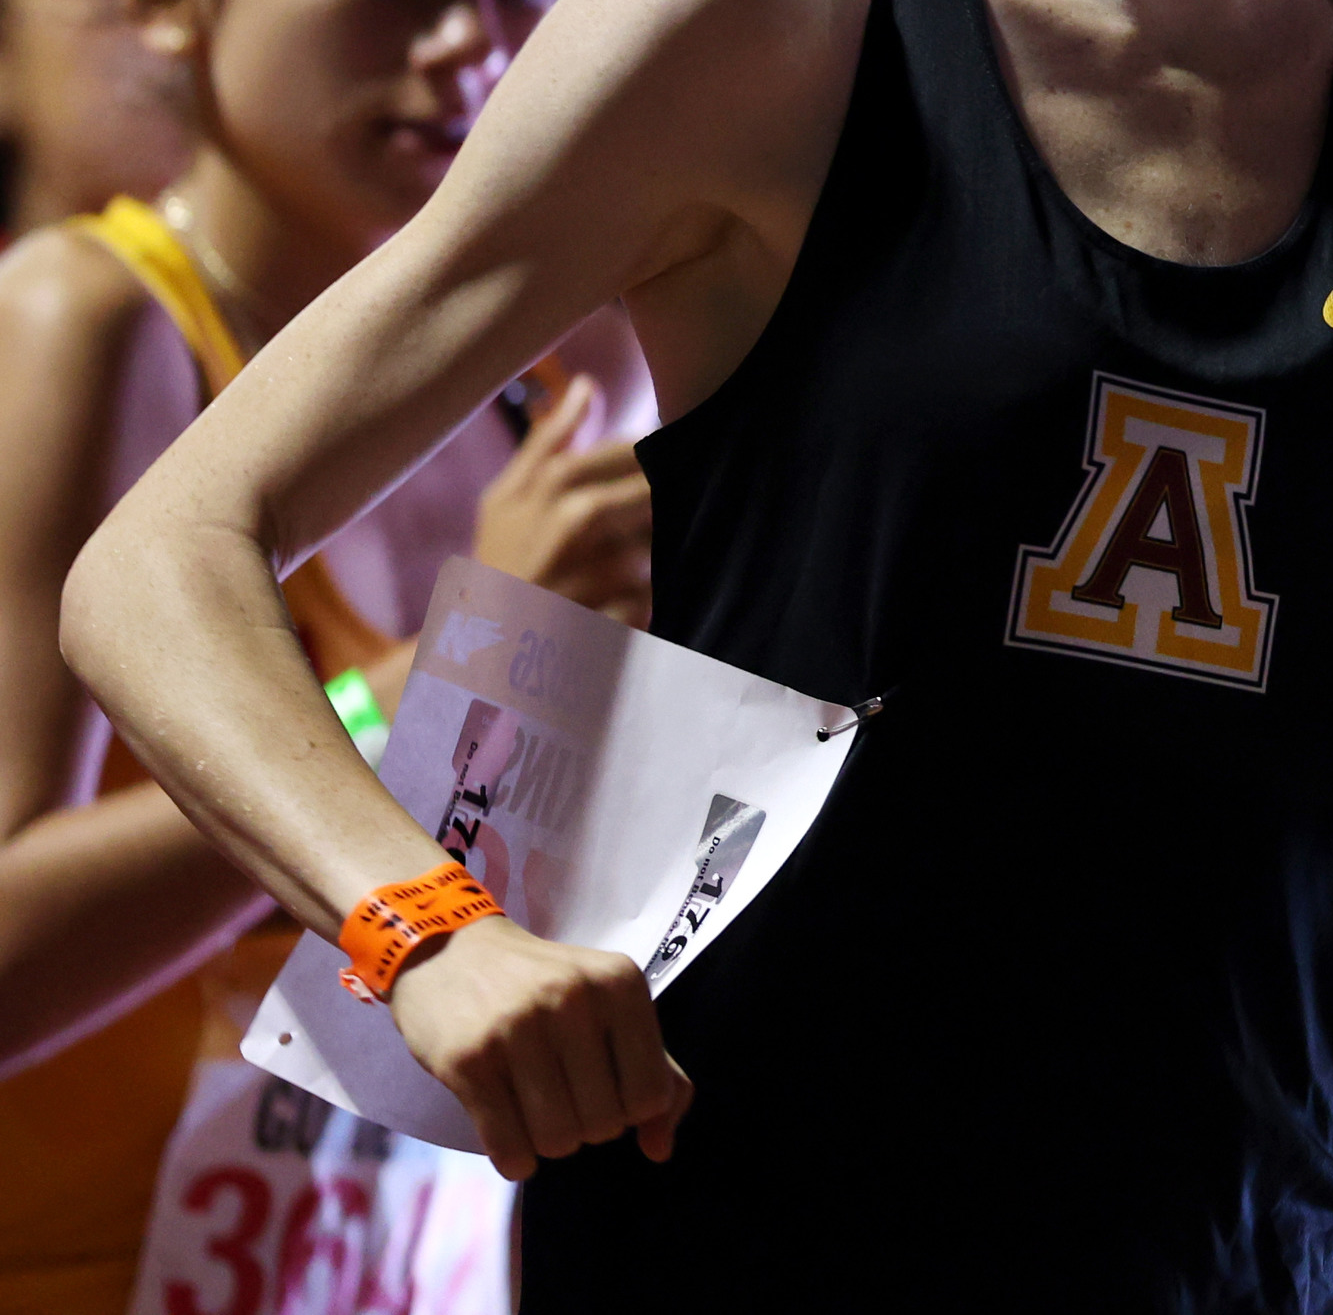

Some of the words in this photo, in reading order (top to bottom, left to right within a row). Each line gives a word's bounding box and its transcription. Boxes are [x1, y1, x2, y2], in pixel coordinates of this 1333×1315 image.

[1004, 369, 1280, 694] A
[698, 857, 711, 881] not
[708, 836, 721, 855] Do
[660, 876, 724, 962] 176
